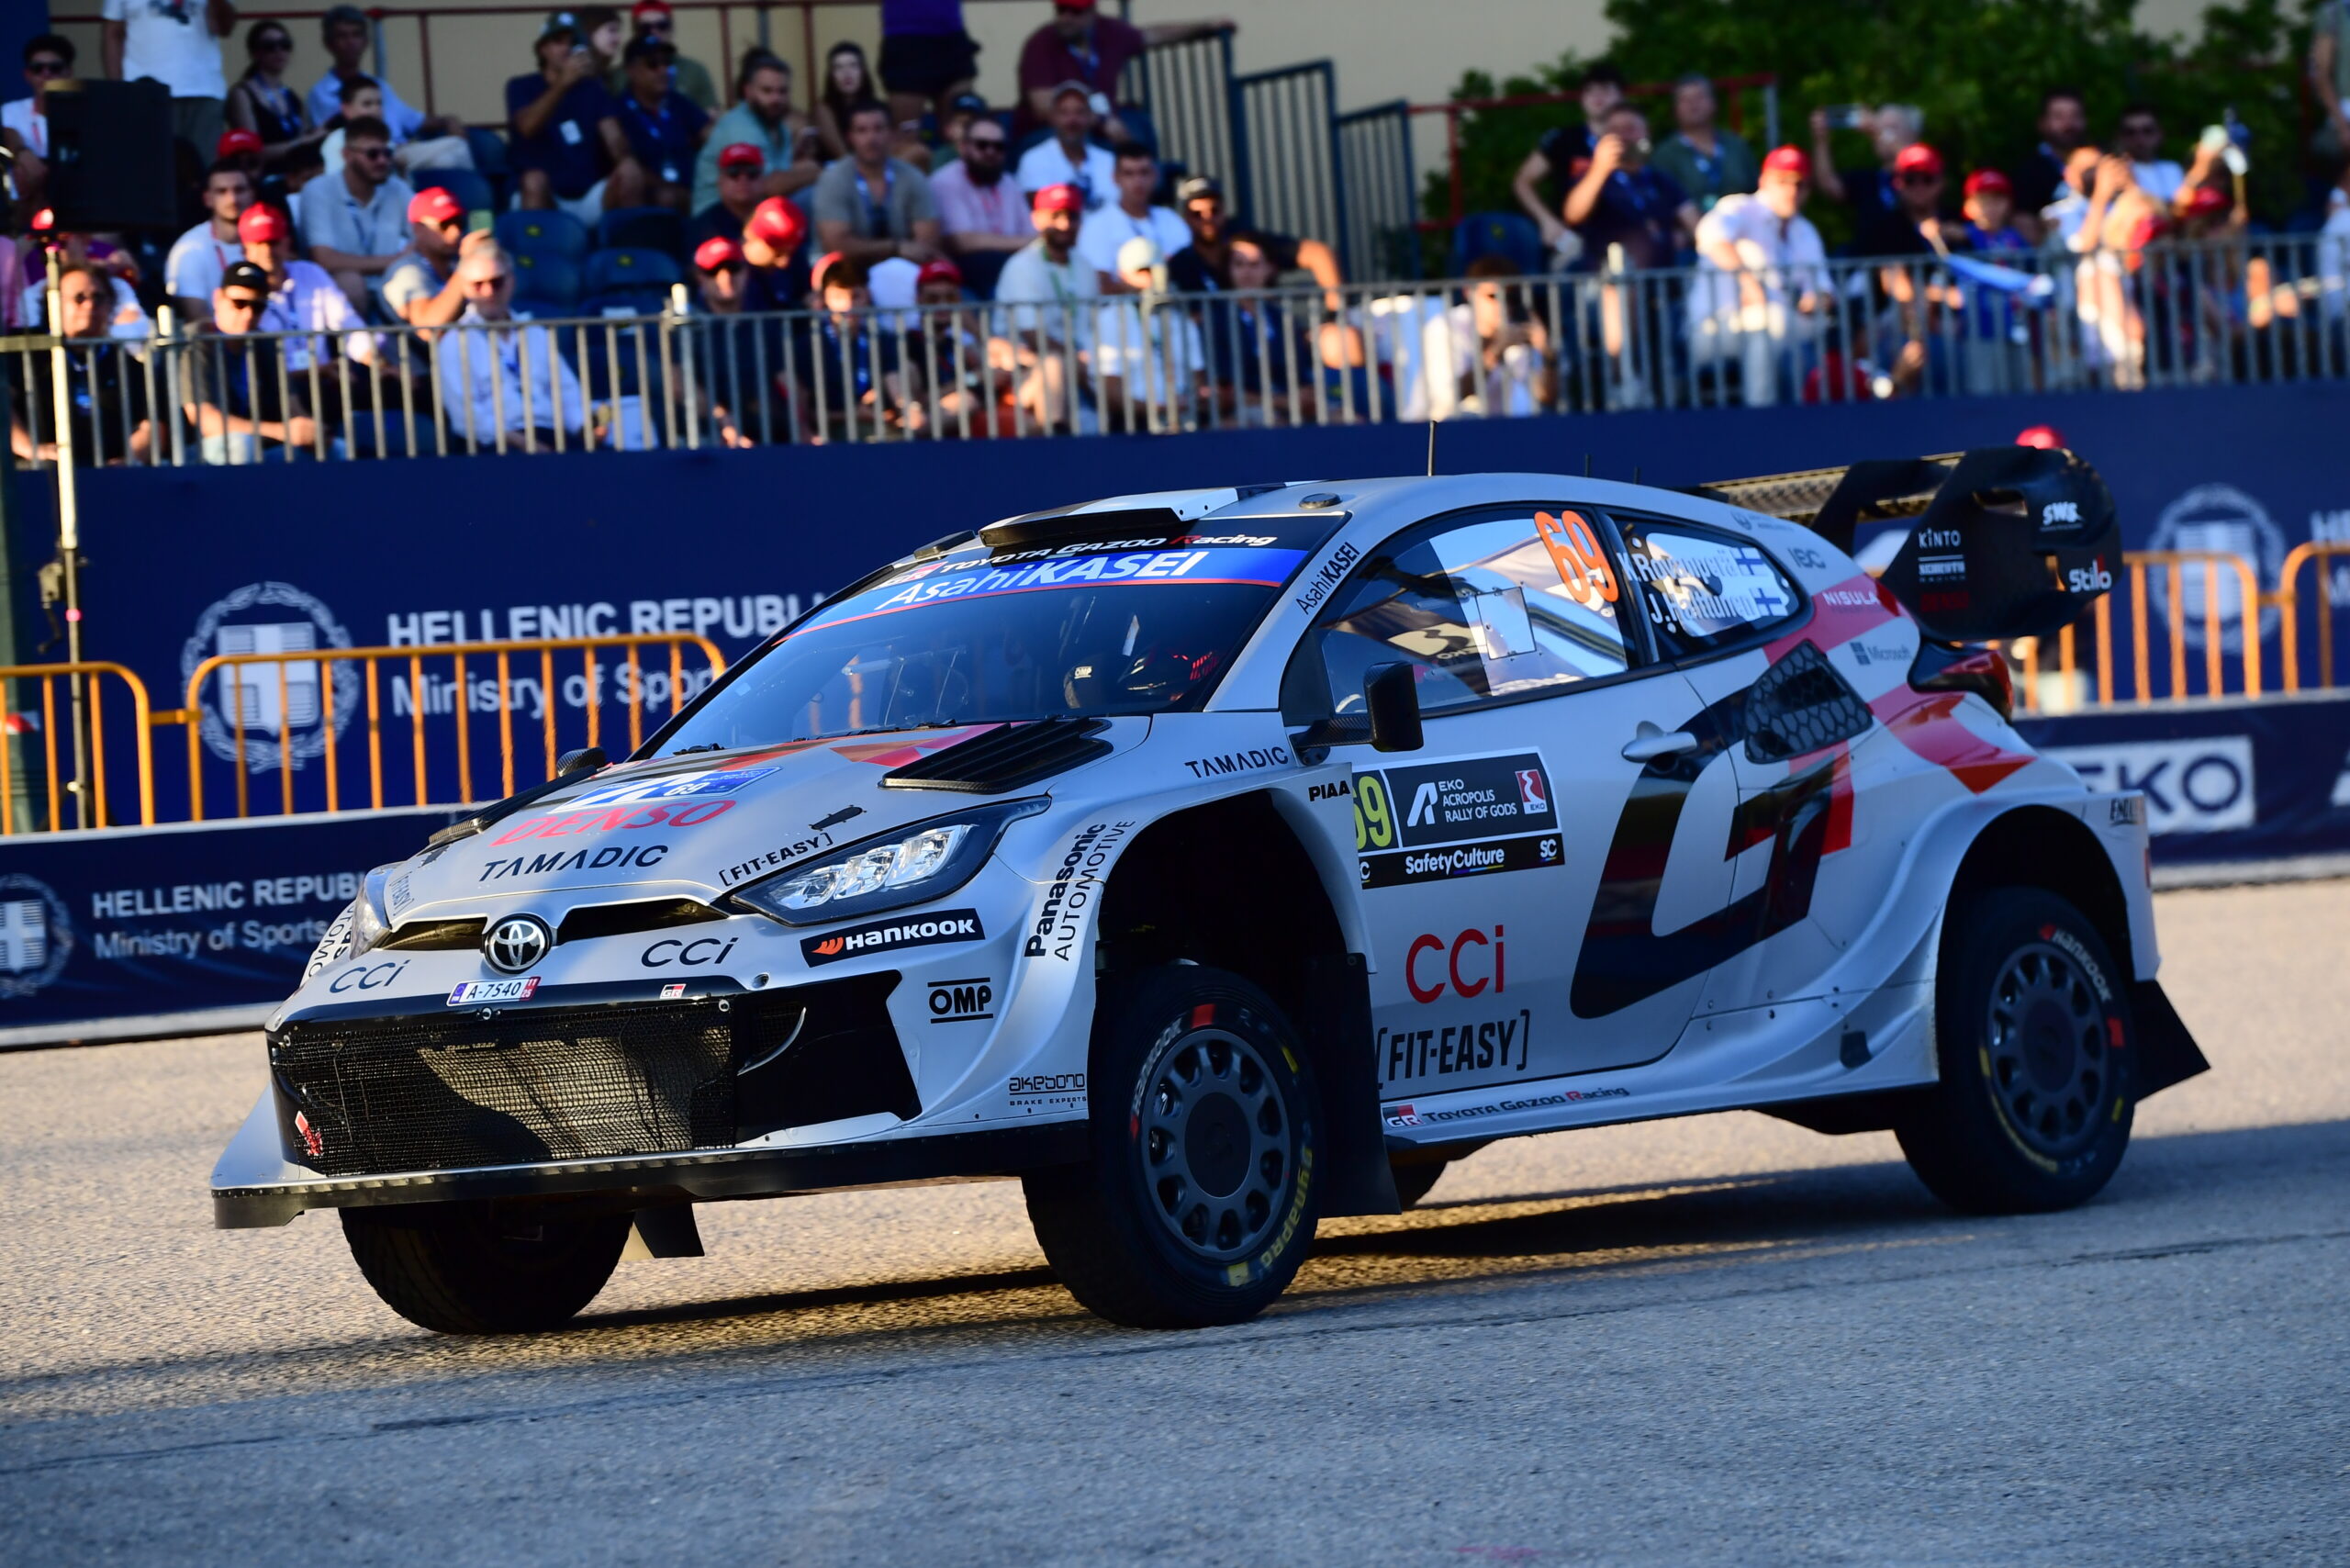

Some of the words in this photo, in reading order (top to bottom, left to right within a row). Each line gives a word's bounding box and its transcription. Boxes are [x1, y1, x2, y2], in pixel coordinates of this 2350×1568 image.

[940, 548, 1053, 574] TOYOTA
[1056, 538, 1167, 555] GAZOO
[1169, 534, 1278, 546] Racing
[1534, 510, 1618, 602] 69
[874, 551, 1210, 610] AsahiKASEI
[1295, 542, 1360, 615] AsahiKASEI
[2069, 554, 2111, 593] Stilo
[1821, 590, 1879, 607] NISULA
[387, 600, 618, 648] HELLENIC
[1184, 745, 1289, 779] TAMADIC
[664, 782, 711, 797] 69
[1308, 780, 1351, 802] PIAA
[1438, 778, 1465, 791] EKO
[1442, 789, 1495, 807] ACROPOLIS
[489, 800, 737, 847] DENSO
[1445, 807, 1472, 823] RALLY
[1475, 806, 1488, 819] OF
[1490, 802, 1517, 817] GODS
[478, 844, 669, 882] TAMADIC
[1405, 847, 1505, 875] SafetyCulture
[1539, 838, 1558, 858] SC
[94, 880, 245, 918] HELLENIC
[1024, 823, 1107, 958] Panasonic
[1054, 820, 1136, 962] AUTOMOTIVE
[95, 928, 200, 959] Ministry
[207, 922, 236, 951] of
[466, 981, 521, 999] A-7540
[662, 986, 685, 999] GR
[929, 983, 992, 1015] OMP
[1049, 1096, 1087, 1104] EXPERTS
[1386, 1114, 1423, 1127] GR
[1422, 1104, 1498, 1122] TOYOTA
[1500, 1094, 1566, 1112] GAZOO
[1565, 1087, 1630, 1102] Racing
